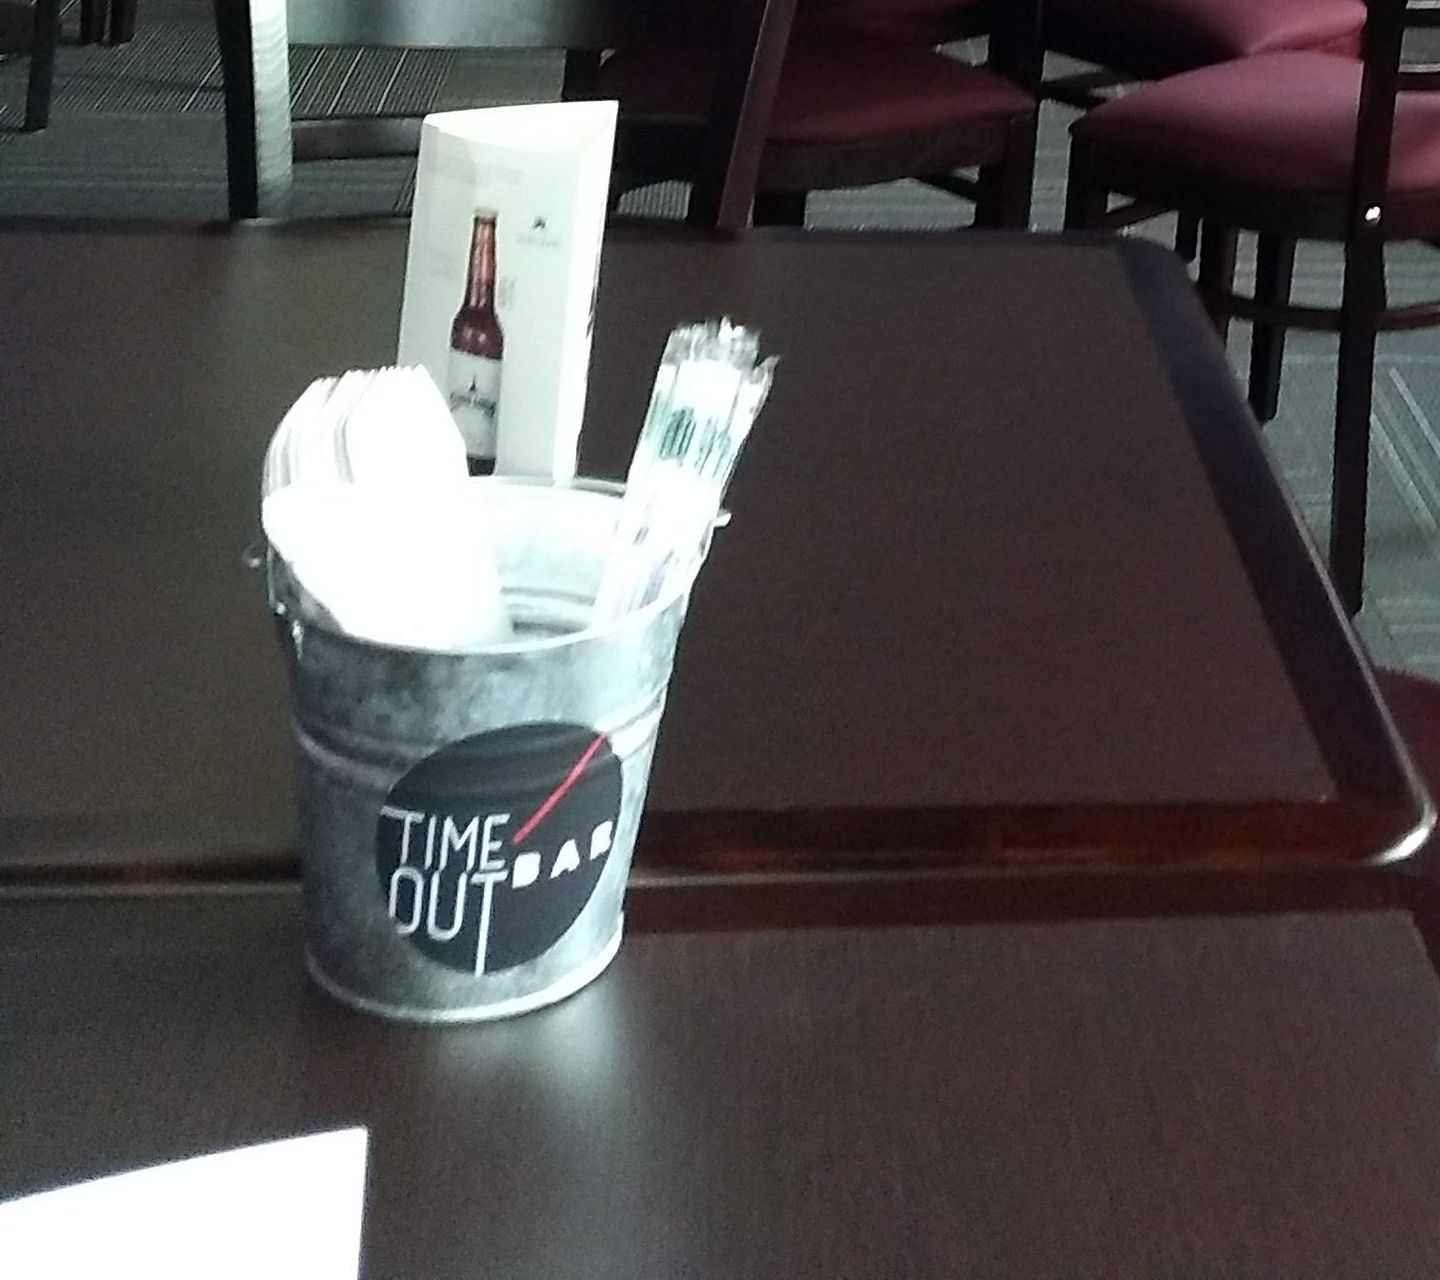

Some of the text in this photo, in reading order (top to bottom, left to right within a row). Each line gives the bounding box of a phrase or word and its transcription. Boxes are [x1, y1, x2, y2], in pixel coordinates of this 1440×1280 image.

[380, 806, 511, 872] TIME
[389, 821, 613, 977] OUT BAR
